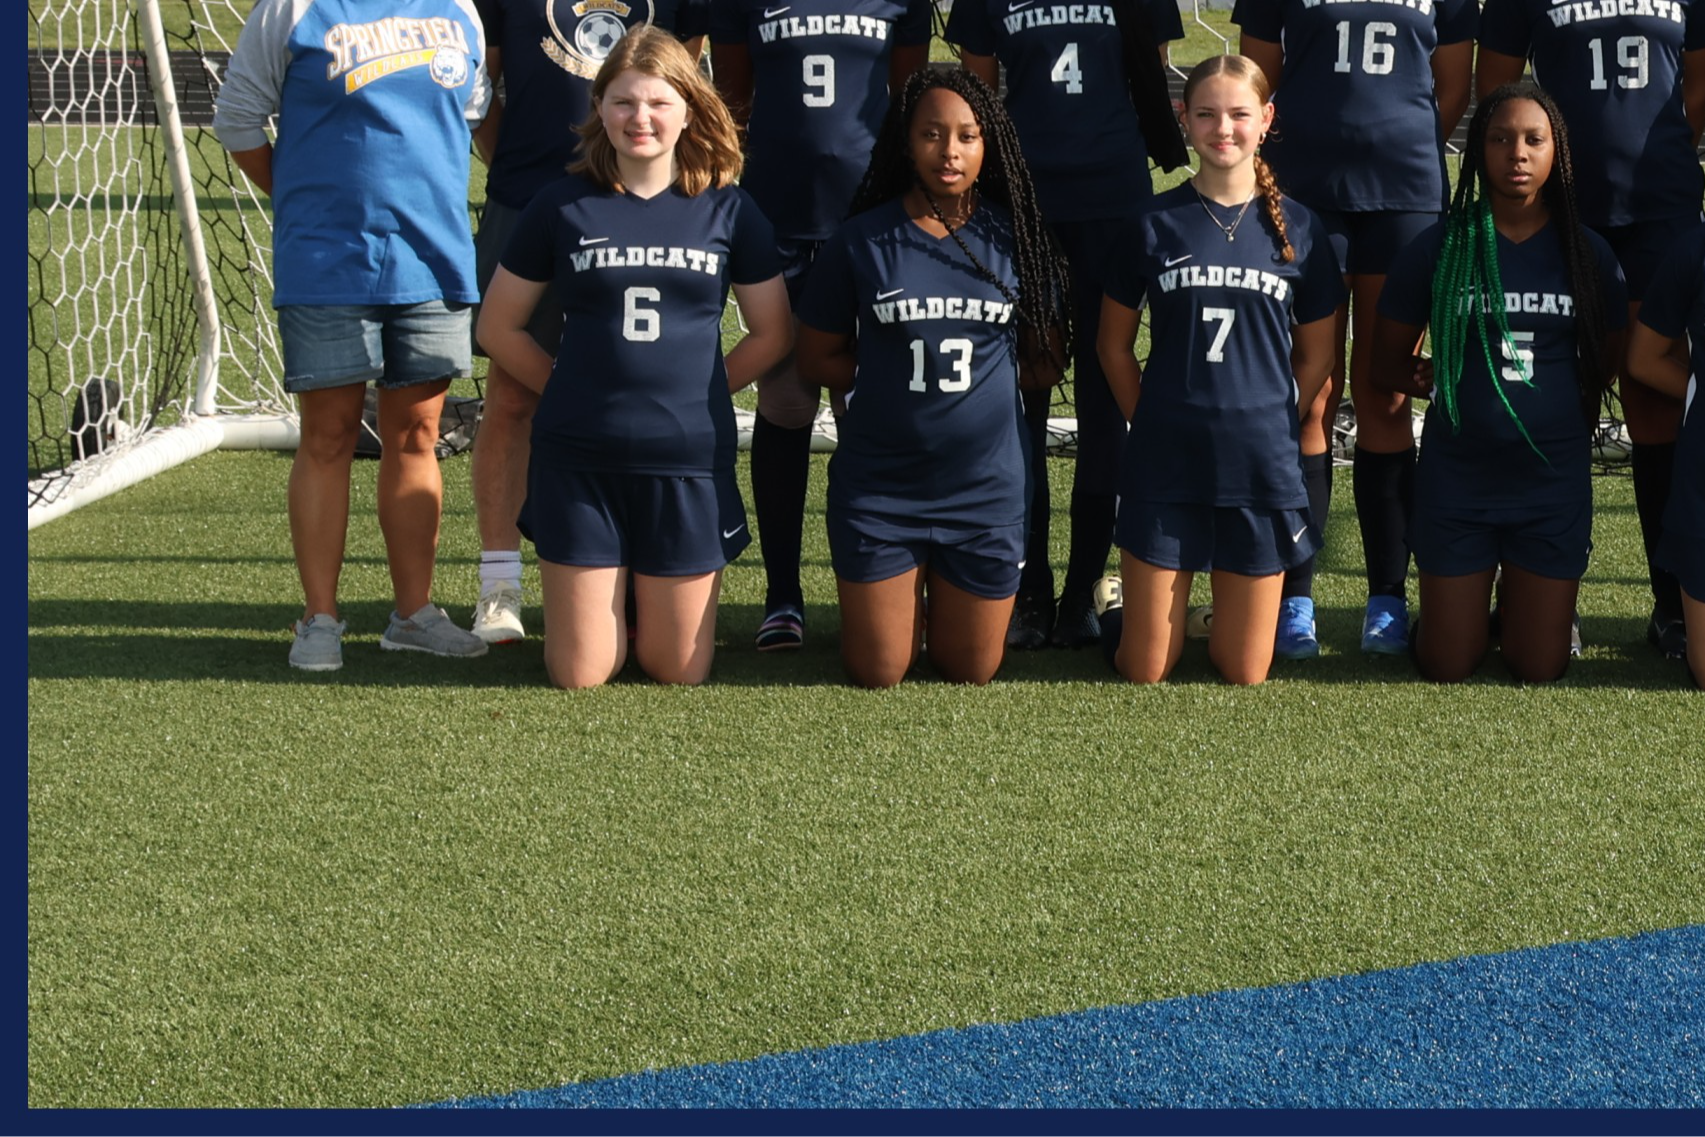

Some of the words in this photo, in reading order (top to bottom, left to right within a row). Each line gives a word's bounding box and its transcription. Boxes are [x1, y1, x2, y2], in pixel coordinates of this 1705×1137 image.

[758, 14, 888, 43] WILDCATS
[1003, 2, 1116, 34] WILDCAT
[354, 53, 423, 86] WILDCATS
[1050, 42, 1083, 94] 4
[1334, 20, 1397, 75] 16
[1588, 35, 1649, 90] 19
[802, 54, 836, 108] 9
[570, 246, 720, 276] WILDCATS
[1158, 265, 1289, 302] WILDCATS
[622, 286, 661, 343] 6
[872, 296, 1014, 324] WILDCATS
[1202, 306, 1236, 363] 7
[909, 338, 974, 393] 13
[1501, 331, 1534, 382] 5
